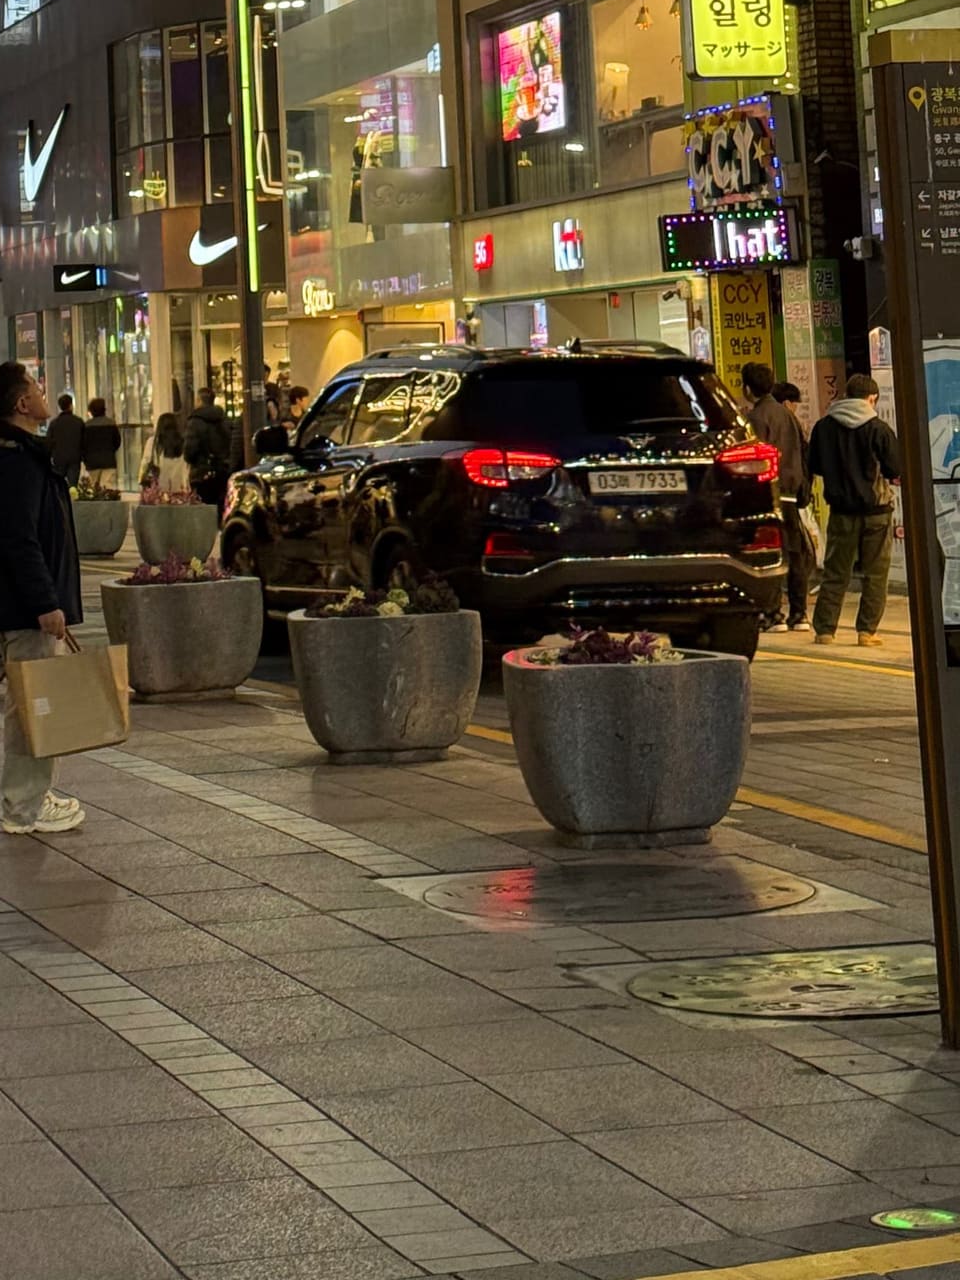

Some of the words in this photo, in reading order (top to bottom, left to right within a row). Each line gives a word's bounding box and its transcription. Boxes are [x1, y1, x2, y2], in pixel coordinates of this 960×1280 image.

[702, 39, 784, 60] マッサージ
[931, 87, 960, 102] 광복
[932, 104, 960, 114] Gwan
[939, 227, 960, 239] 남포
[723, 283, 763, 305] CCY
[724, 311, 767, 331] 코인노래
[729, 335, 763, 356] 연습장
[635, 472, 678, 489] 7933
